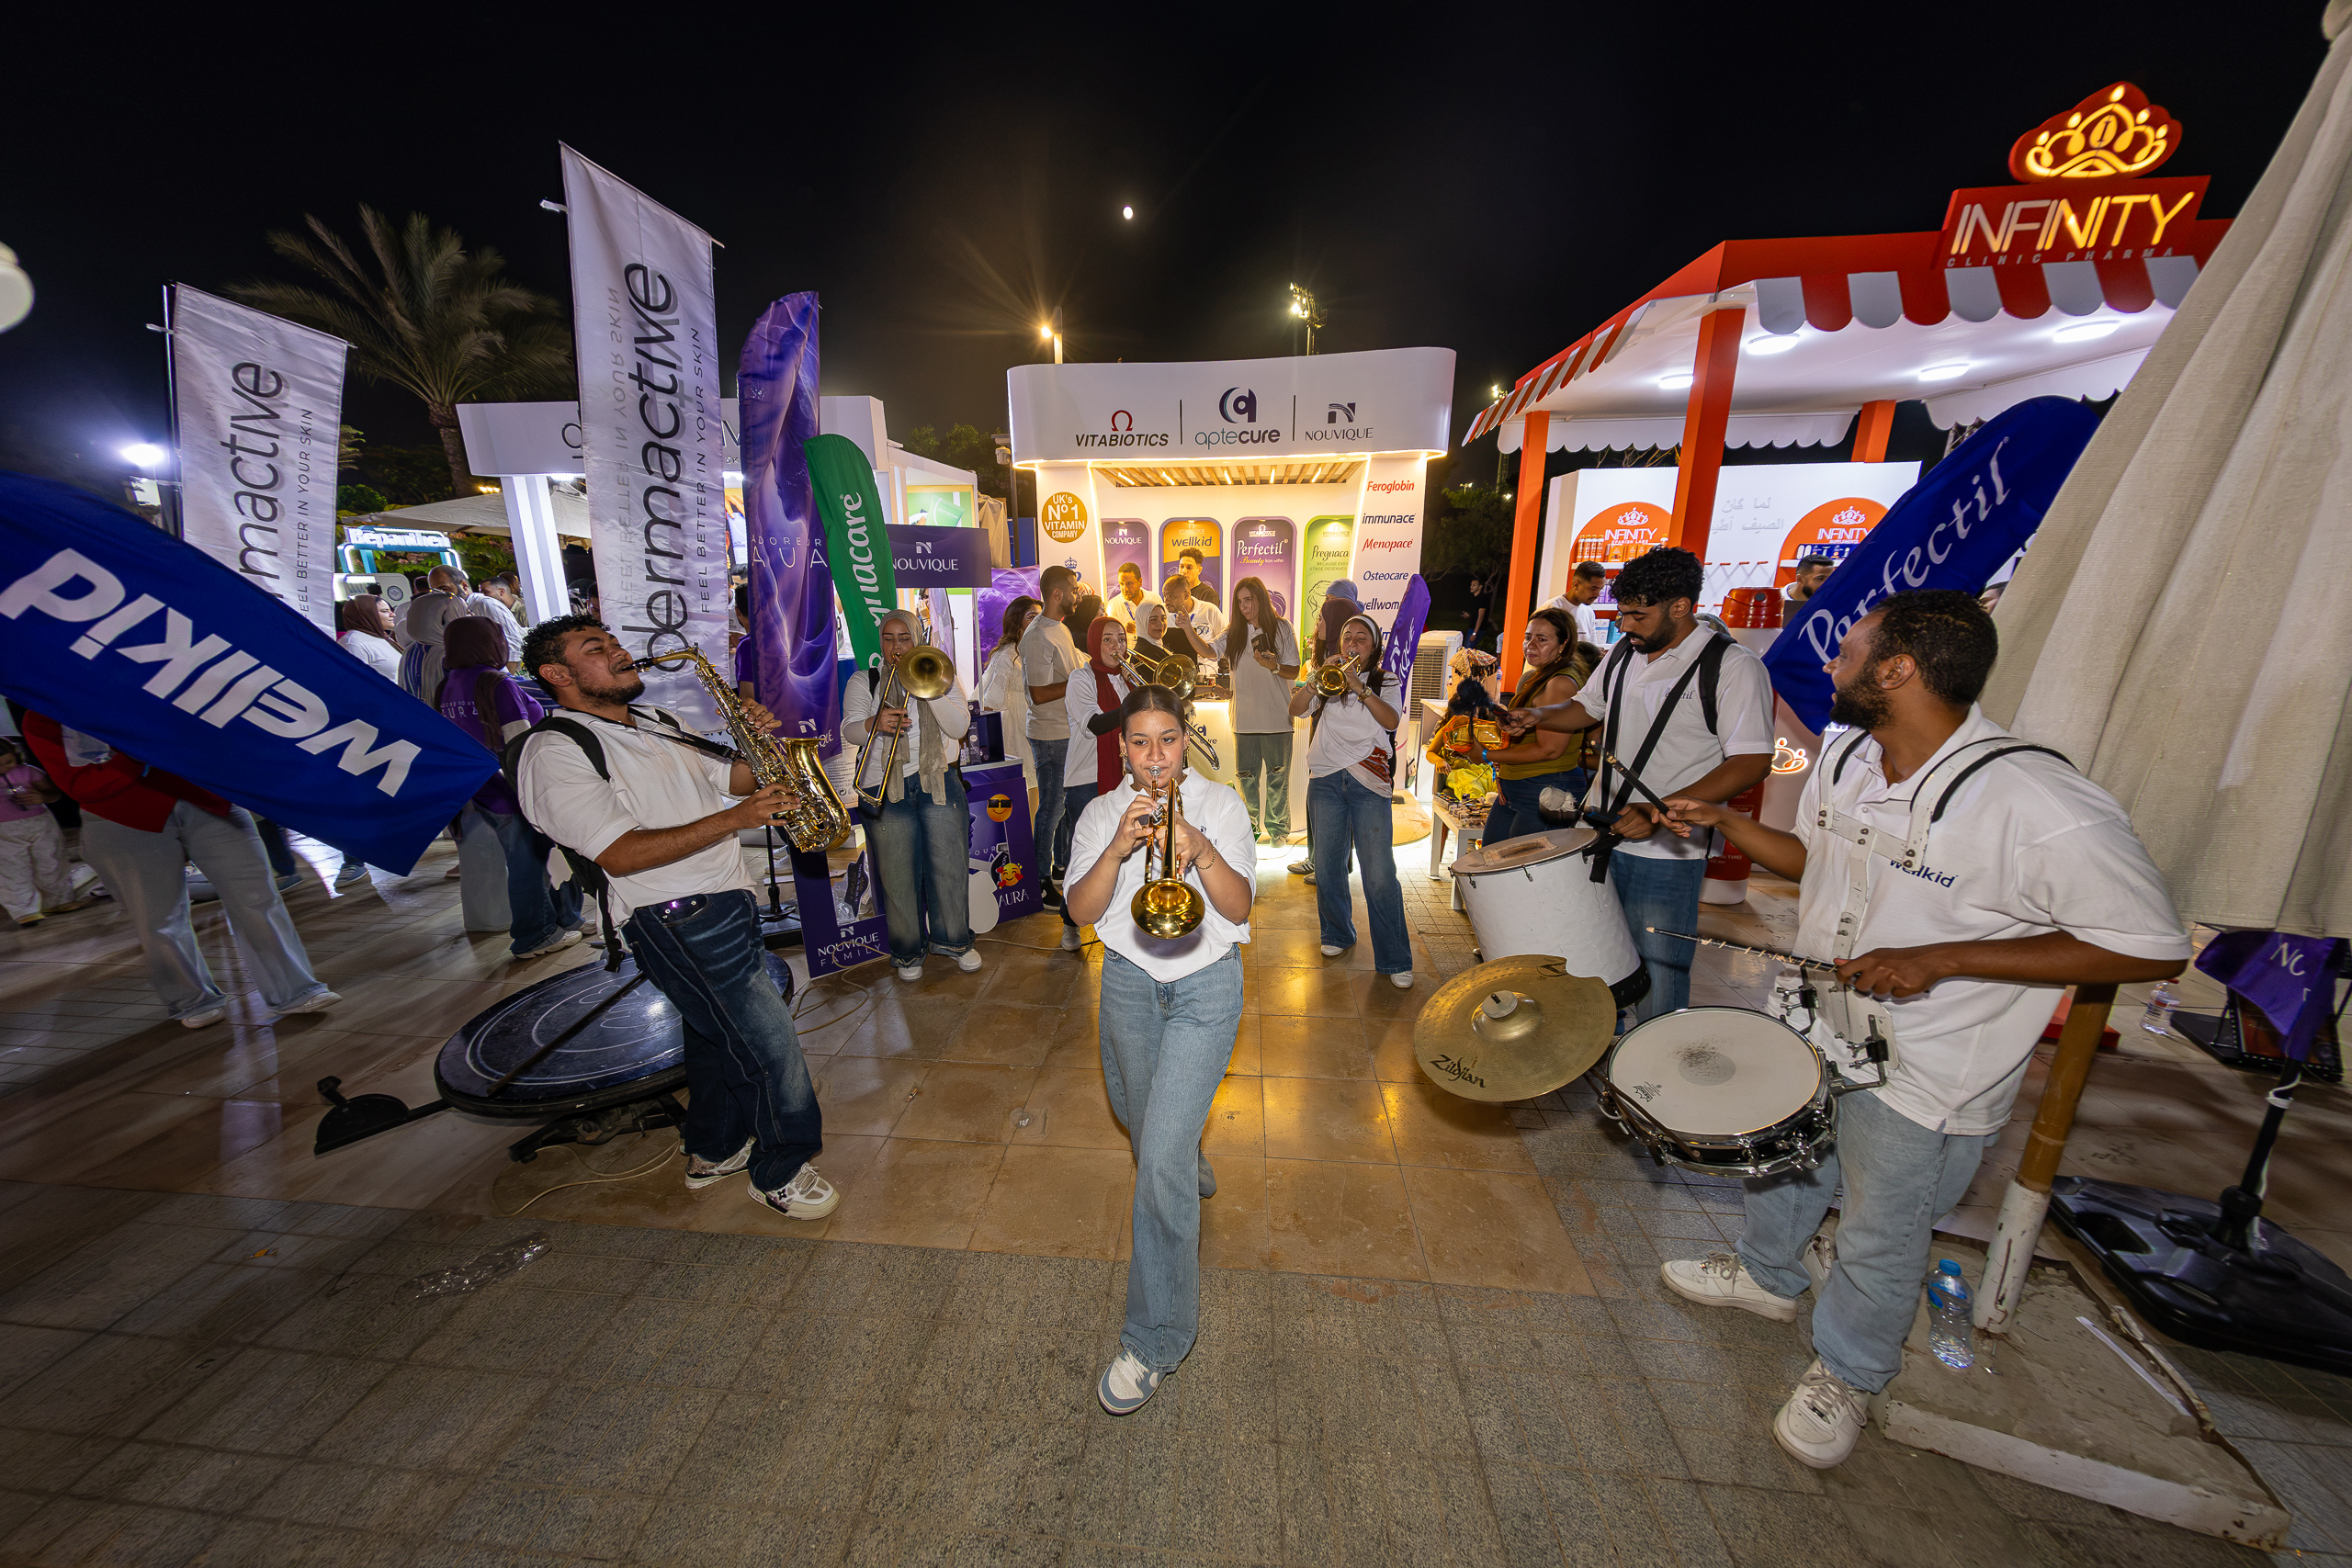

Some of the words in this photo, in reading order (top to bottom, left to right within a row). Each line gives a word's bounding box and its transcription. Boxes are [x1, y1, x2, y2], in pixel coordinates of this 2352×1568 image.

[1950, 190, 2196, 255] INFINITY
[1946, 253, 2043, 268] CLINIC
[2065, 246, 2175, 263] PHARMA
[689, 327, 704, 378] SKIN
[693, 386, 707, 443] YOUR
[300, 408, 313, 446] SKIN
[1305, 427, 1374, 442] NOUVIQUE
[1075, 433, 1170, 447] VITABIOTICS
[1194, 427, 1281, 450] aptecure
[297, 450, 311, 493] YOUR
[621, 262, 689, 672] dermactive
[695, 454, 707, 473] IN
[220, 361, 284, 599] mactive
[1366, 479, 1415, 494] Feroglobin
[298, 500, 310, 516] IN
[1052, 494, 1073, 504] UK's
[695, 483, 707, 558] BETTER
[1070, 503, 1079, 520] 1
[1362, 513, 1416, 525] immunace
[1044, 520, 1085, 531] VITAMIN
[1051, 530, 1079, 539] COMPANY
[1604, 528, 1658, 540] INFINITY
[1816, 527, 1872, 540] INFINITY
[1104, 536, 1143, 545] NOUVIQUE
[1171, 536, 1213, 547] wellkid
[1237, 540, 1284, 558] Perfectil
[1362, 538, 1414, 552] Menopace
[297, 522, 310, 579] BETTER
[1311, 545, 1349, 561] Pregnaca
[892, 558, 959, 572] NOUVIQUE
[1363, 570, 1409, 581] Osteocare
[696, 566, 711, 614] FEEL
[0, 547, 423, 797] wellkid
[999, 888, 1030, 908] AURA
[817, 931, 880, 957] NOUVIQUE
[820, 942, 881, 967] FAMILY
[1429, 1054, 1487, 1089] Zildjian
